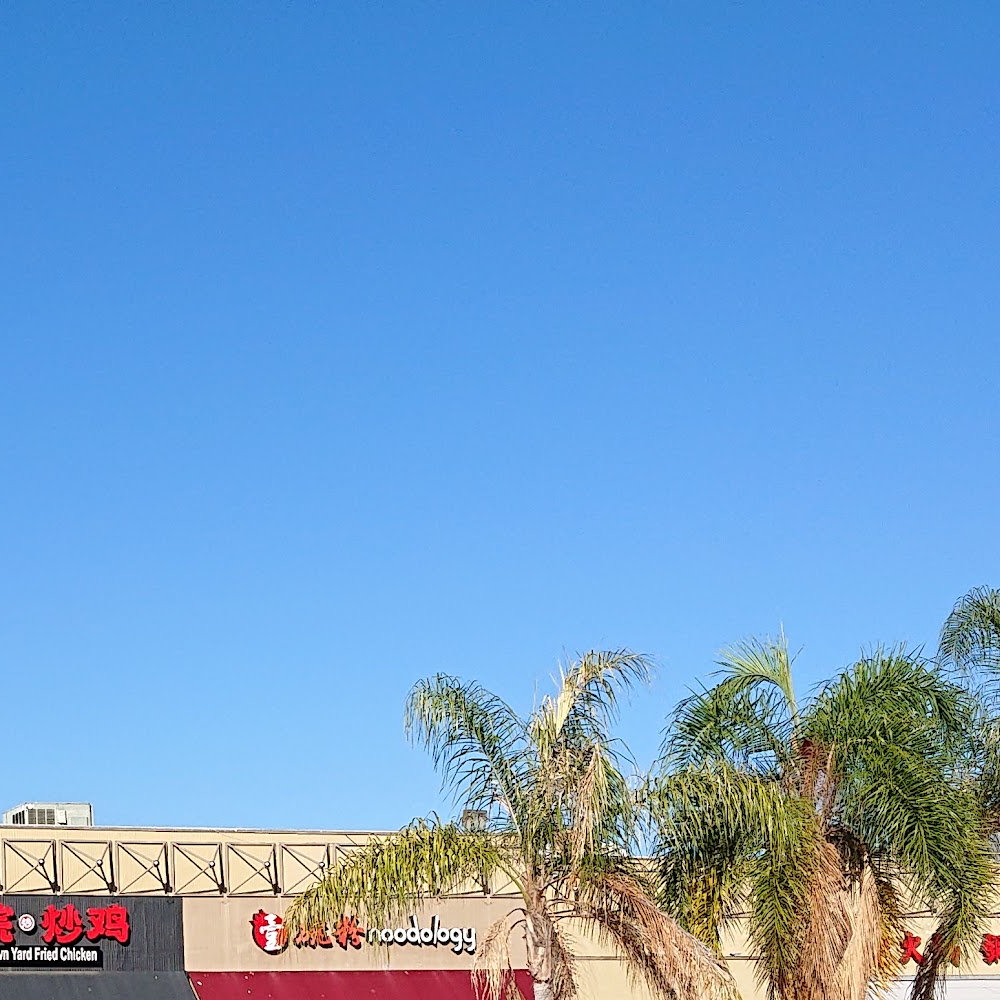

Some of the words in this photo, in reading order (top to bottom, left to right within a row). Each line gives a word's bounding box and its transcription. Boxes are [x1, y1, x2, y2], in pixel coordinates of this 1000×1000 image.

[40, 903, 130, 943] 炒鸡
[368, 914, 477, 951] noodology
[10, 946, 33, 961] Yard
[34, 946, 59, 961] Fried
[59, 946, 98, 962] Chicken
